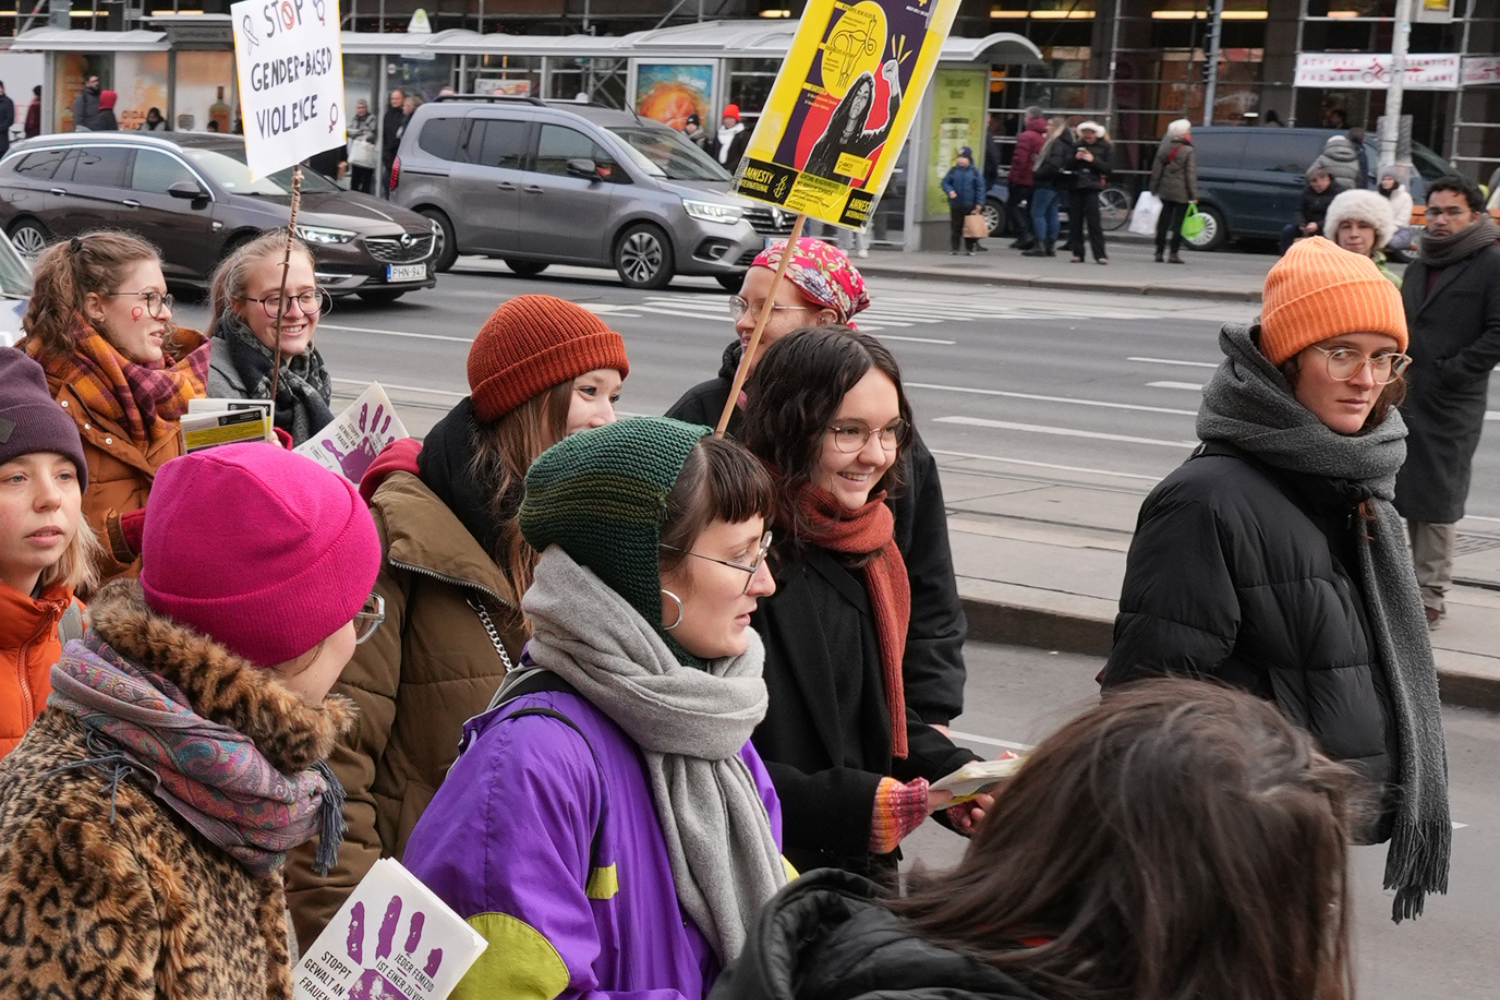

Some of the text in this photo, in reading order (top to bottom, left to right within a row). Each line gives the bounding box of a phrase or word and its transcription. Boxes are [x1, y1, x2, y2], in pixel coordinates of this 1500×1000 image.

[251, 47, 333, 92] GENDER-BASED
[256, 94, 318, 140] VIOLENCE
[304, 958, 346, 997] GEWALT AN
[321, 950, 352, 980] STOPPT
[376, 960, 389, 973] IST
[386, 969, 407, 990] EINER
[403, 984, 414, 997] ZU
[394, 952, 435, 993] JEDER FEMIZID
